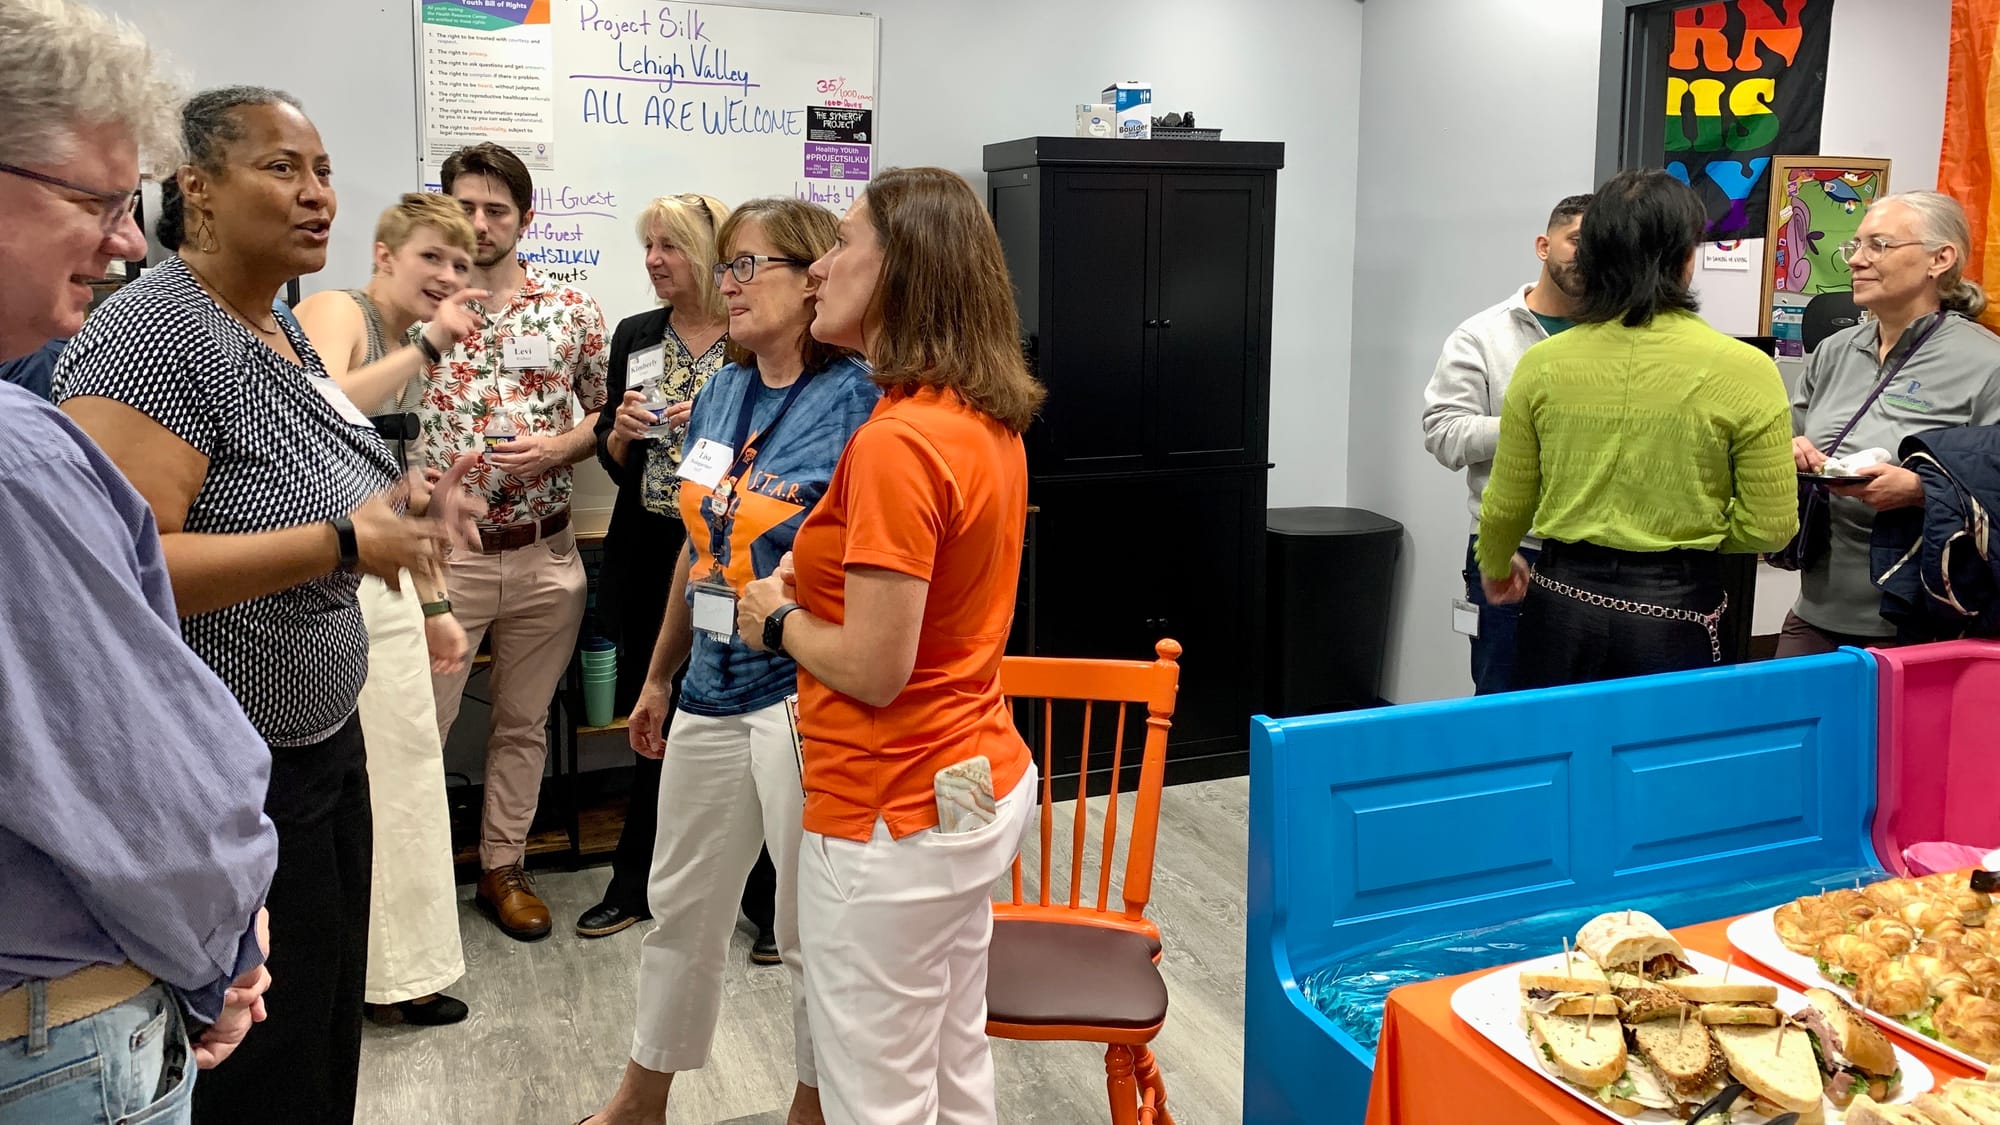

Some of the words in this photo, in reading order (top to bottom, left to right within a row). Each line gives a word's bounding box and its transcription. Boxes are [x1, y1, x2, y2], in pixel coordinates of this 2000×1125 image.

[506, 2, 527, 10] Rights
[580, 0, 651, 40] Project
[659, 6, 712, 42] Silk
[1669, 0, 1807, 72] RN
[618, 42, 684, 93] Lehigh
[690, 43, 749, 96] Valley
[584, 88, 629, 125] ALL
[645, 95, 694, 131] ARE
[702, 96, 805, 136] WELCOME
[828, 112, 864, 122] SYNERGY
[823, 120, 855, 130] PROJECT
[1119, 124, 1148, 134] Boulder
[806, 153, 869, 164] #PROJECTSILKLV
[816, 146, 839, 154] Healthy
[795, 181, 841, 204] What's
[524, 222, 584, 242] H-Guest
[749, 470, 804, 504] S.T.A.R.
